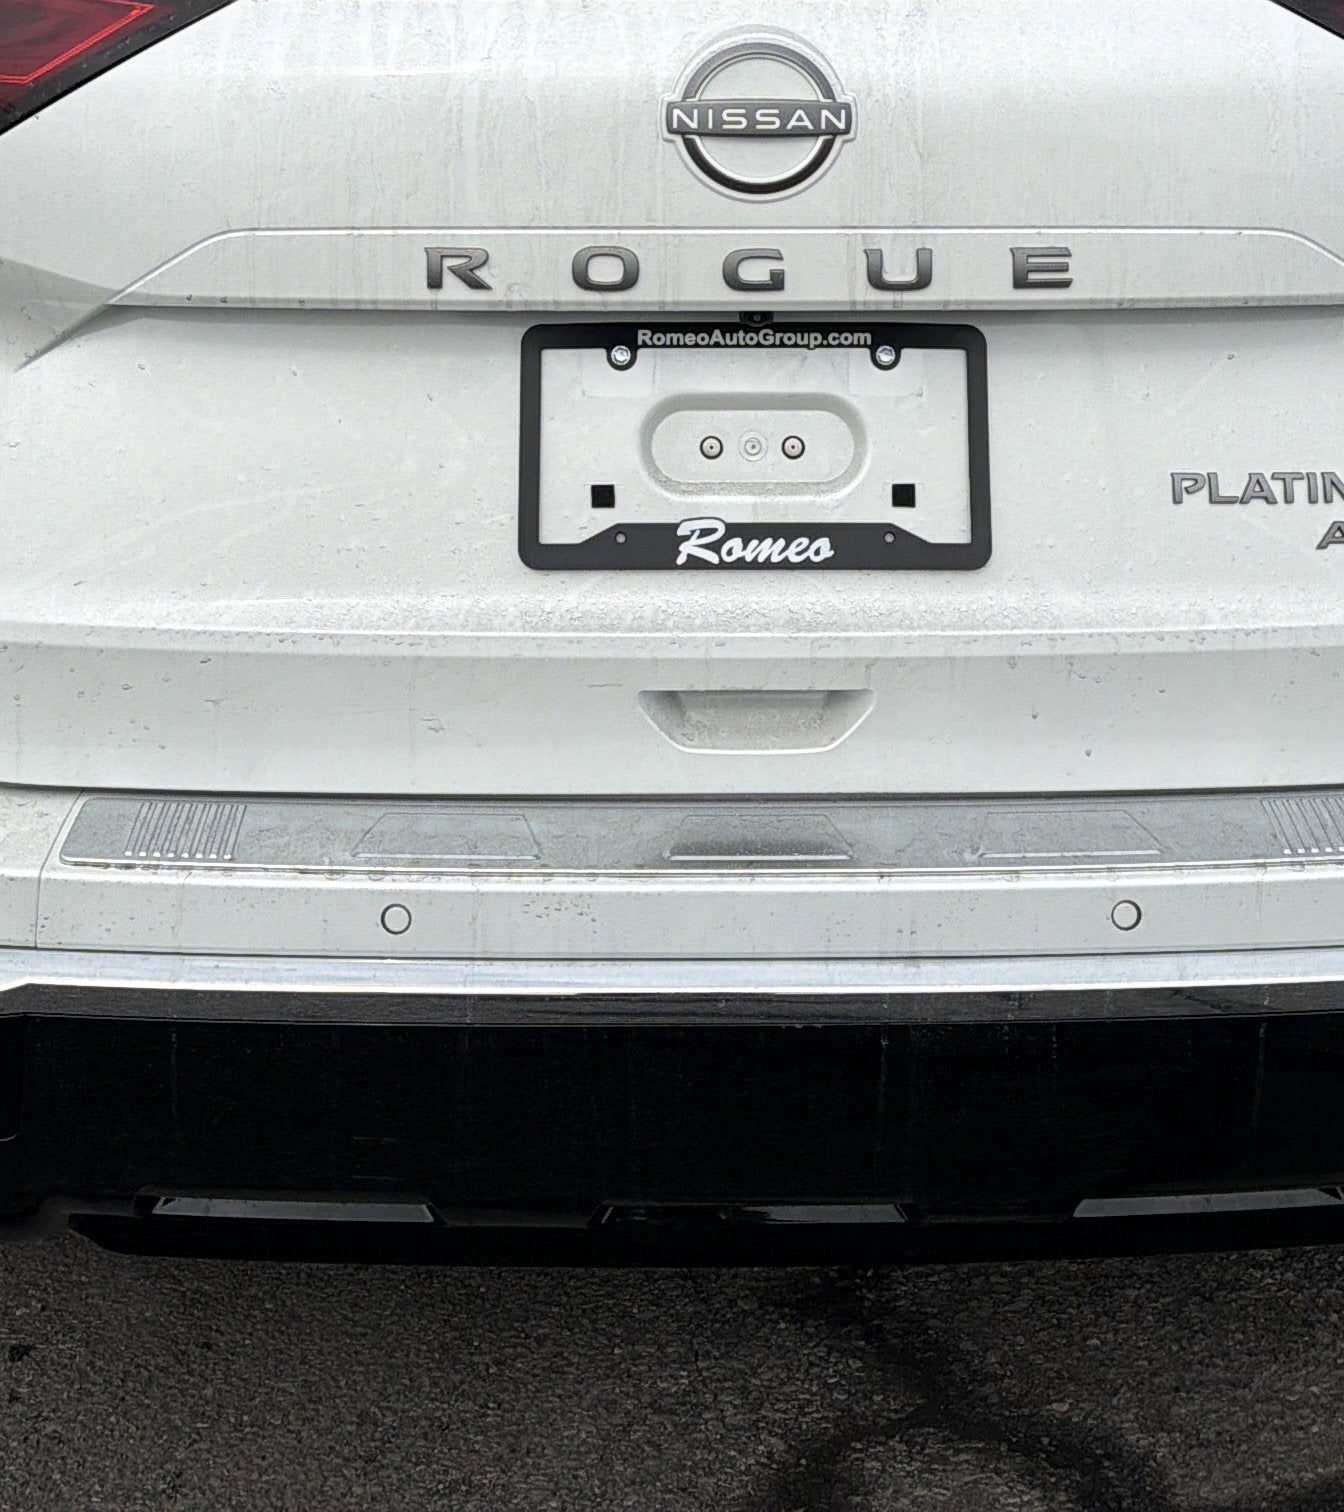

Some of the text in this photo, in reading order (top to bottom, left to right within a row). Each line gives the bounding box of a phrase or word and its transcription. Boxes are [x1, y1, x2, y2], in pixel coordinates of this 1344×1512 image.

[671, 108, 847, 131] NISSAN
[423, 245, 1074, 291] ROGUE
[636, 328, 873, 349] RomeoAutoGroup.com
[675, 518, 835, 566] Romeo
